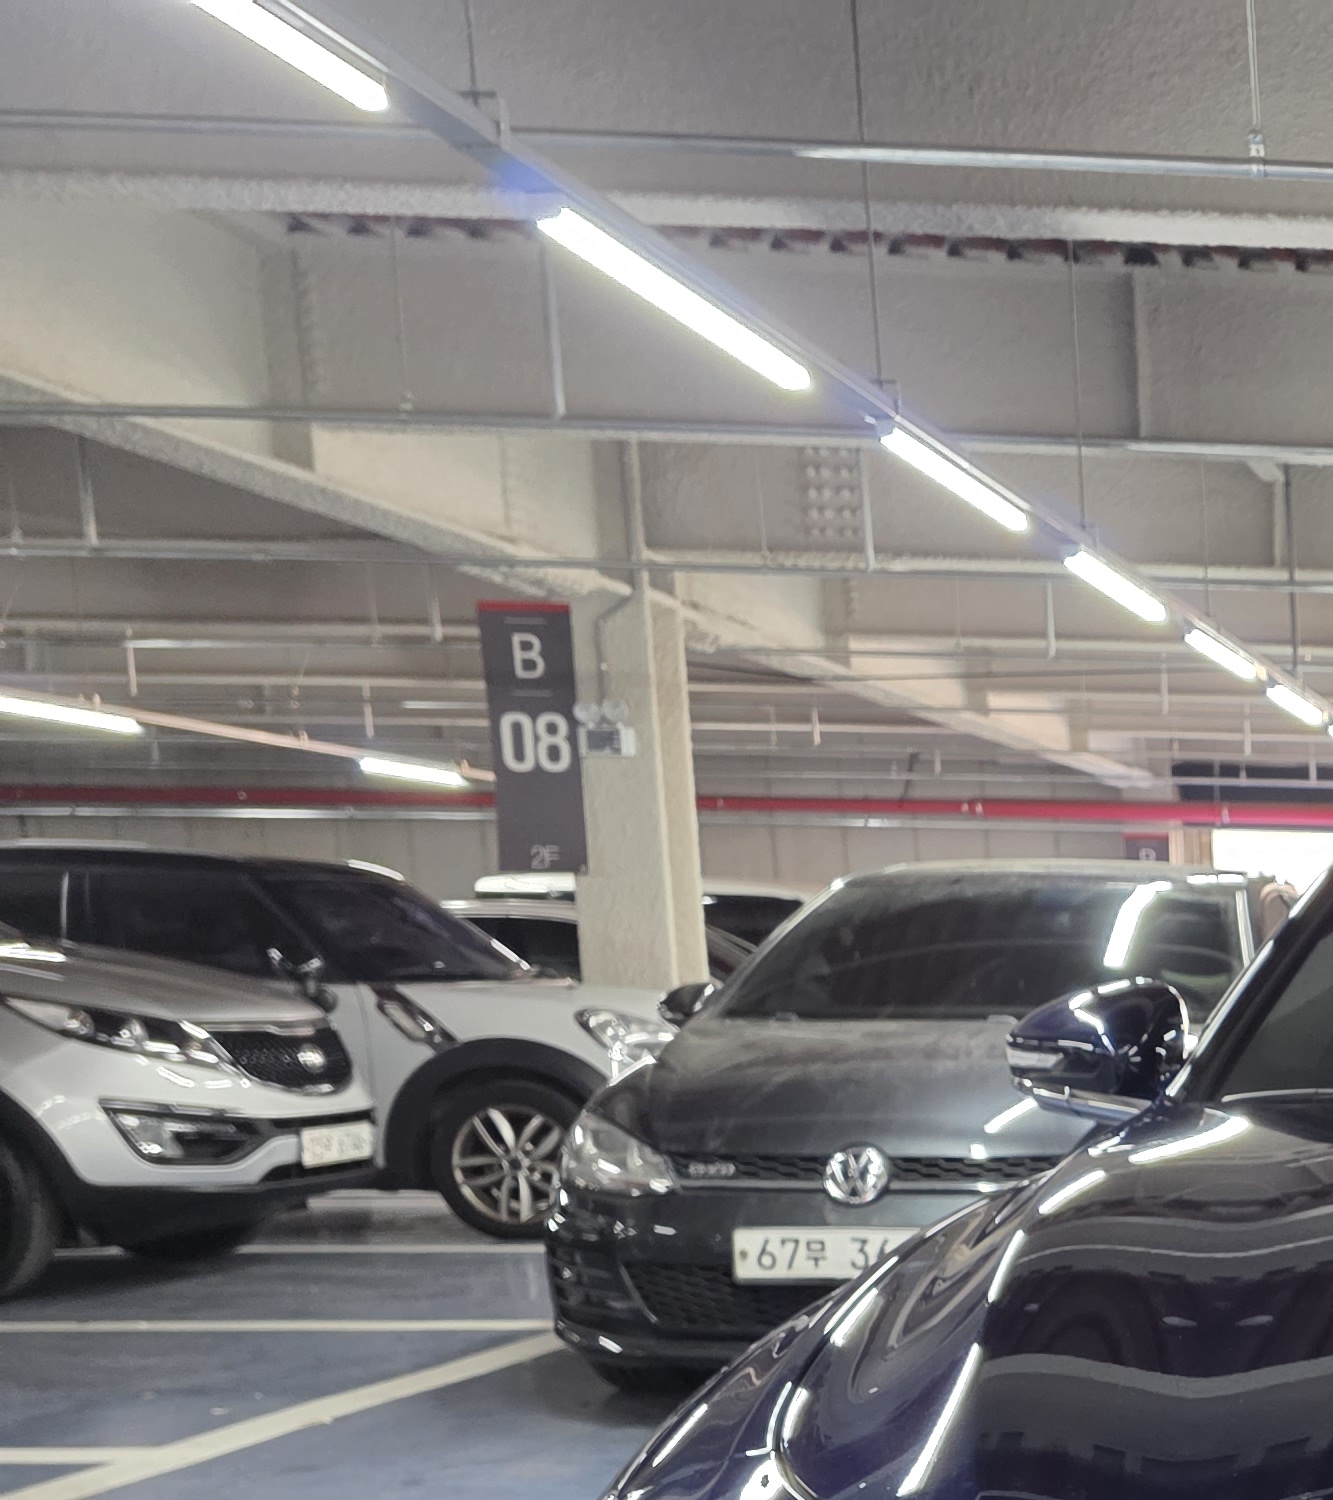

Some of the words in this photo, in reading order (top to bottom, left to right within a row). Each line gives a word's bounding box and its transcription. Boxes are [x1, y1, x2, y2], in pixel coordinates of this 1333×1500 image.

[510, 631, 546, 680] B
[499, 710, 572, 774] 08
[756, 1236, 828, 1272] 67무
